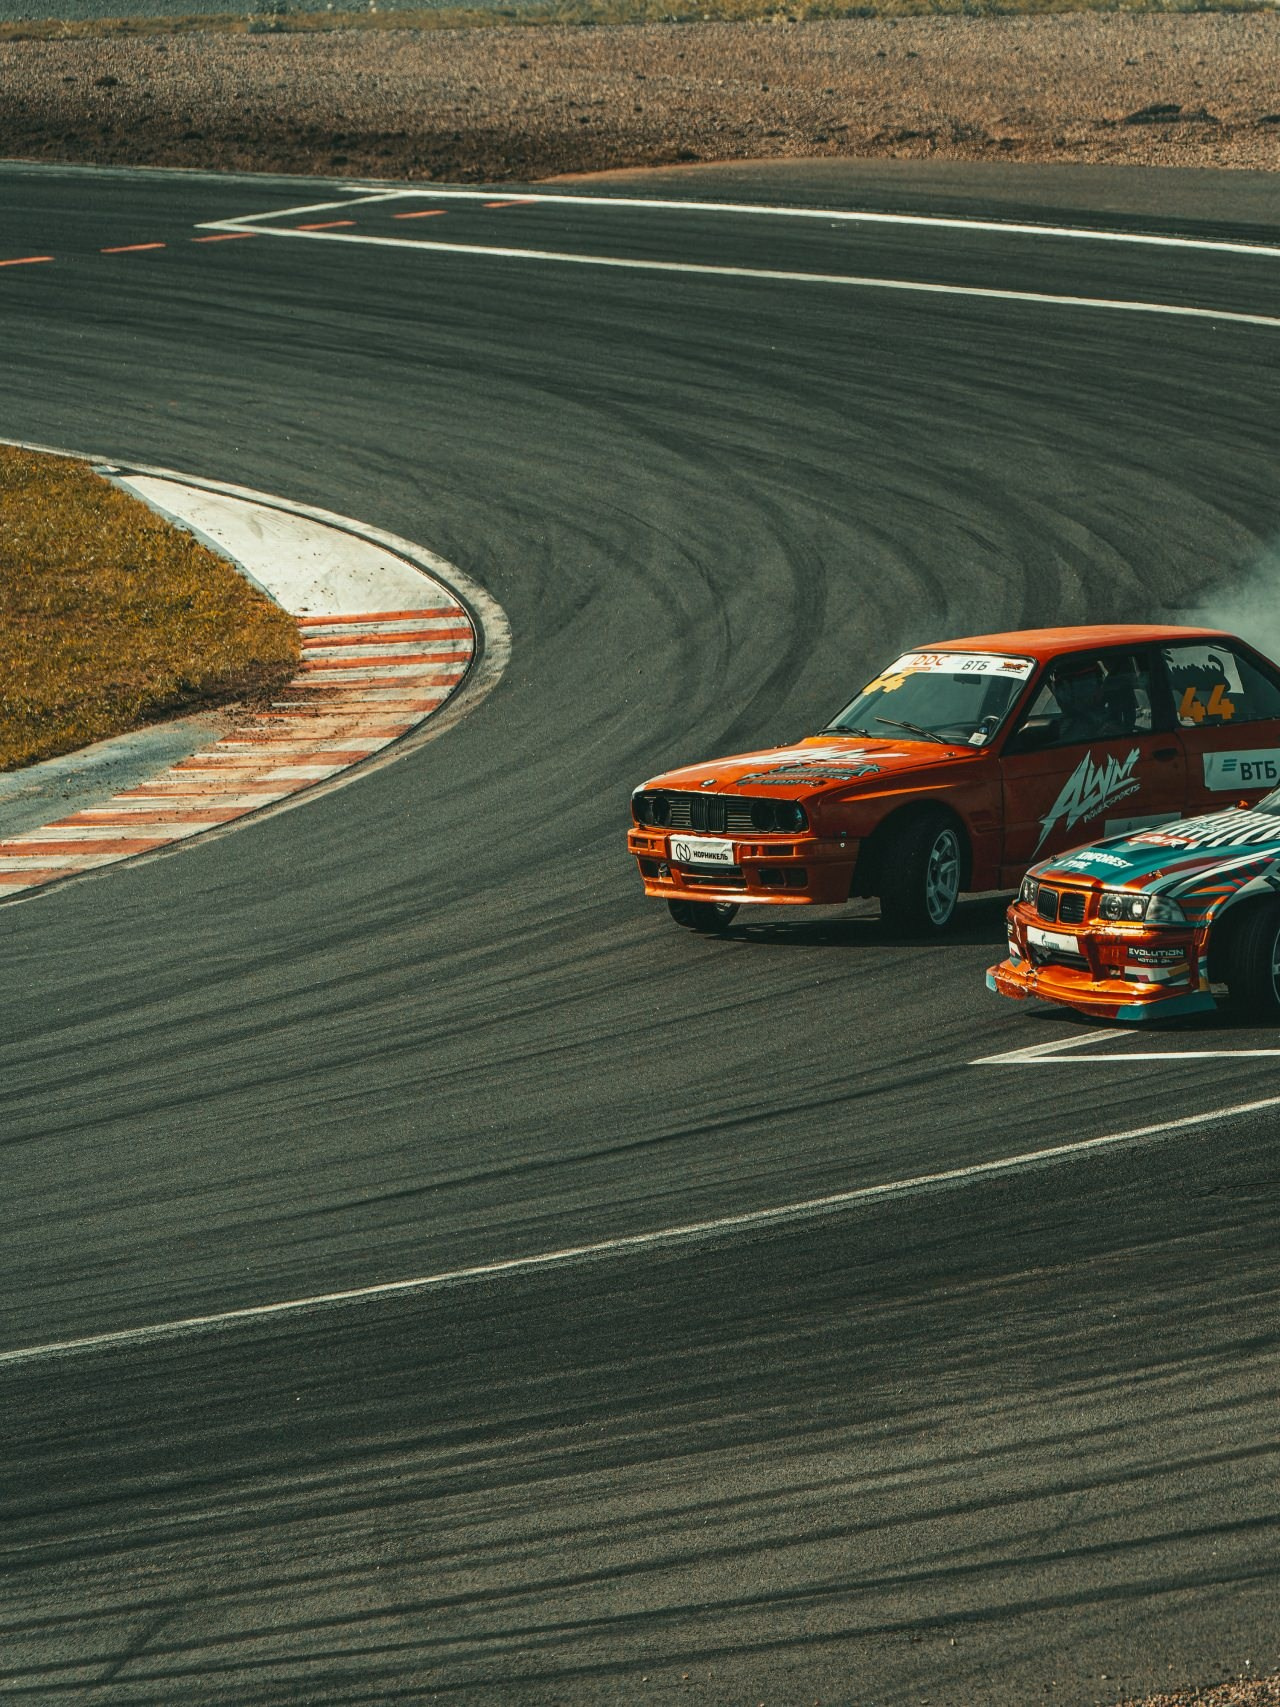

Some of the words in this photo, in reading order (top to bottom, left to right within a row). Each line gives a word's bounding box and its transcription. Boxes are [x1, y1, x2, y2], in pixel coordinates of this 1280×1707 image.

[961, 660, 990, 671] ВТБ
[1180, 685, 1235, 722] 44
[1240, 760, 1278, 781] ВТБ
[692, 850, 729, 861] НОРНИКЕЛЬ
[1128, 947, 1184, 957] EVOLUTION
